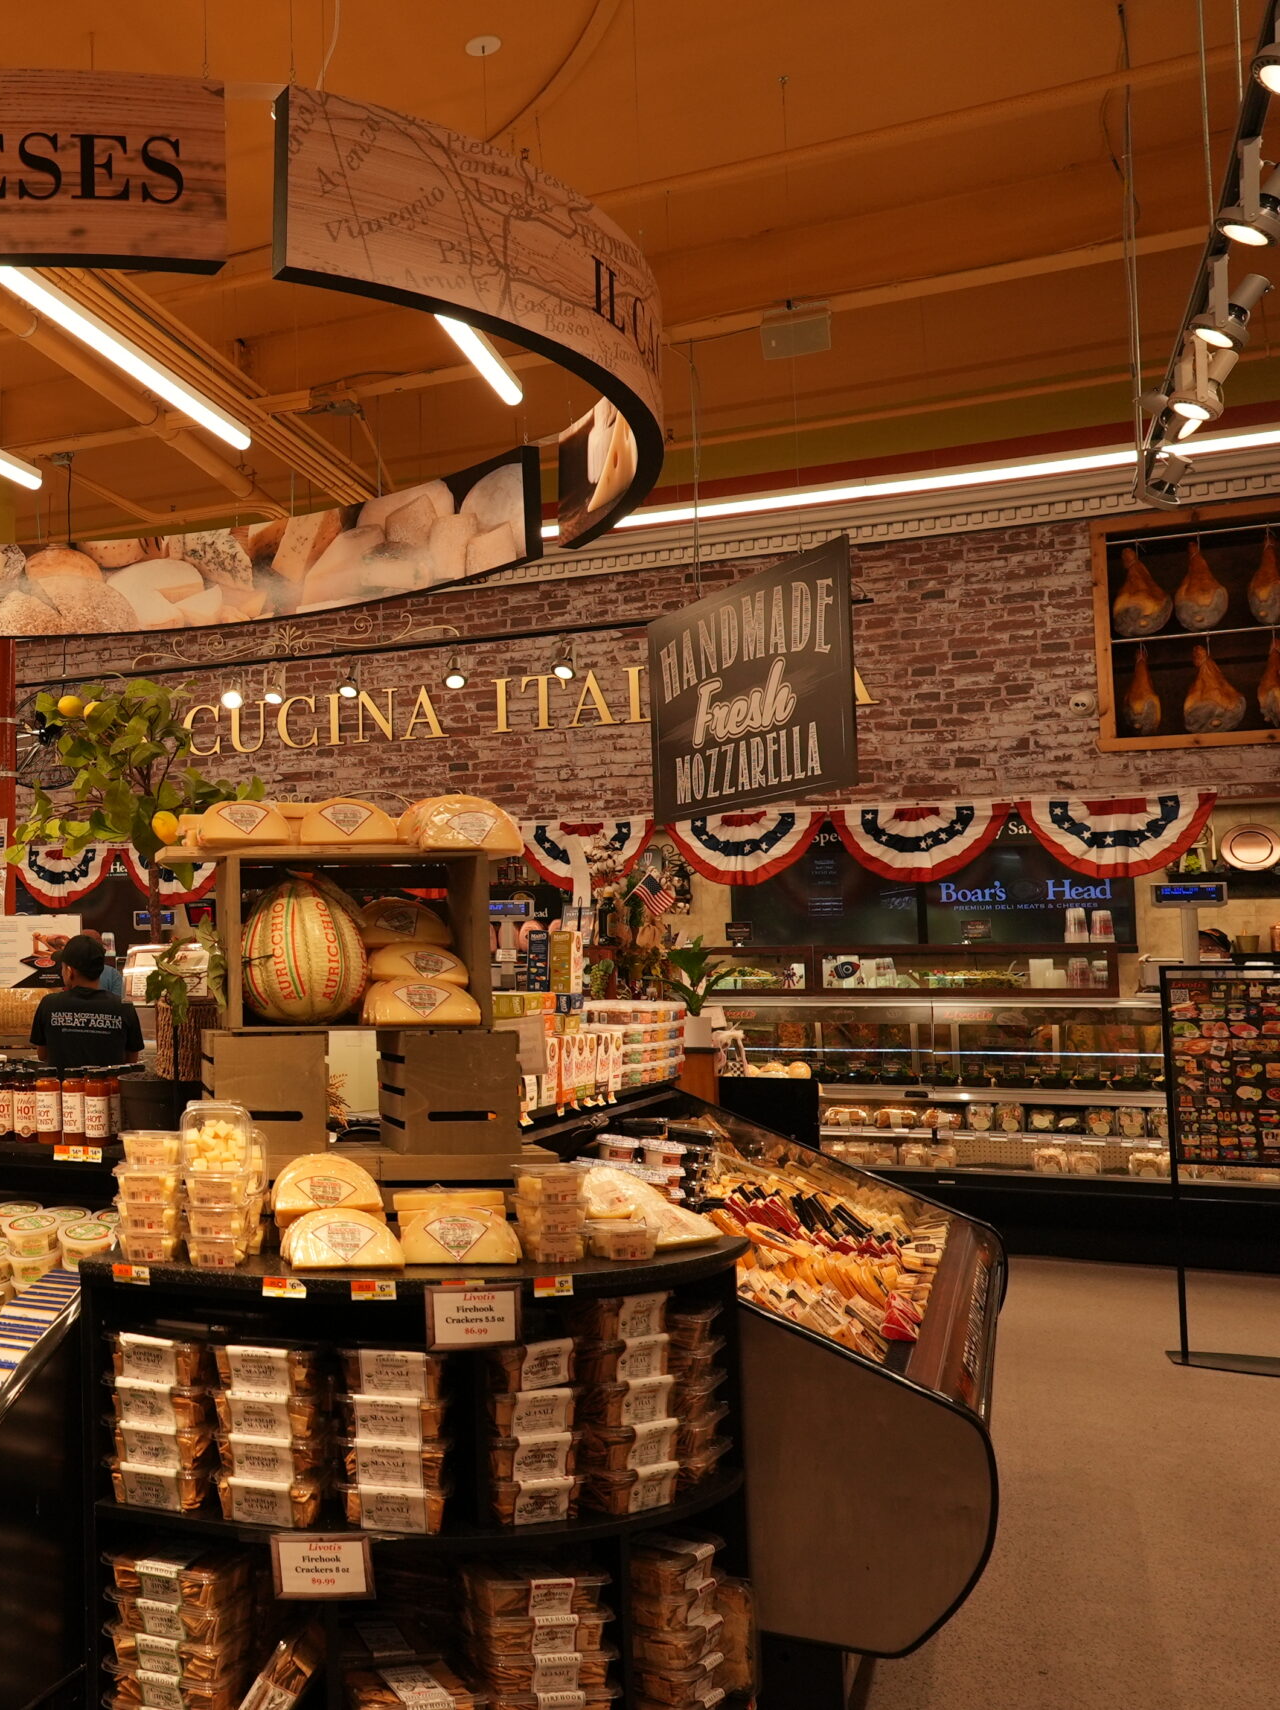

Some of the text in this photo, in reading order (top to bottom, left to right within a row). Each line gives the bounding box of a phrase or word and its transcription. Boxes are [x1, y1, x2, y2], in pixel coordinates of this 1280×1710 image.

[436, 238, 497, 267] Pisa
[591, 254, 626, 335] IL
[545, 315, 590, 337] Bosco
[659, 577, 834, 704] HANDMADE
[691, 656, 797, 748] Fresh
[183, 685, 450, 757] CUCINA
[675, 720, 822, 804] MOZZARELLA
[939, 878, 1113, 903] Boar's Head
[953, 904, 992, 912] PREMIUM
[1017, 903, 1044, 911] MEATS
[271, 901, 297, 1000] AURICCHIO
[315, 900, 340, 1000] AURICCHIO
[51, 1012, 122, 1021] MAKE MOZZARELLA
[51, 1018, 122, 1030] GREAT AGAIN
[16, 1106, 35, 1115] HOT
[456, 1305, 494, 1313] Firehook
[445, 1316, 483, 1324] Crackers
[464, 1327, 488, 1335] $6.99
[302, 1555, 341, 1563] Firehook
[540, 1656, 579, 1664] FIREHOOK
[542, 1694, 581, 1702] FIREHOOK
